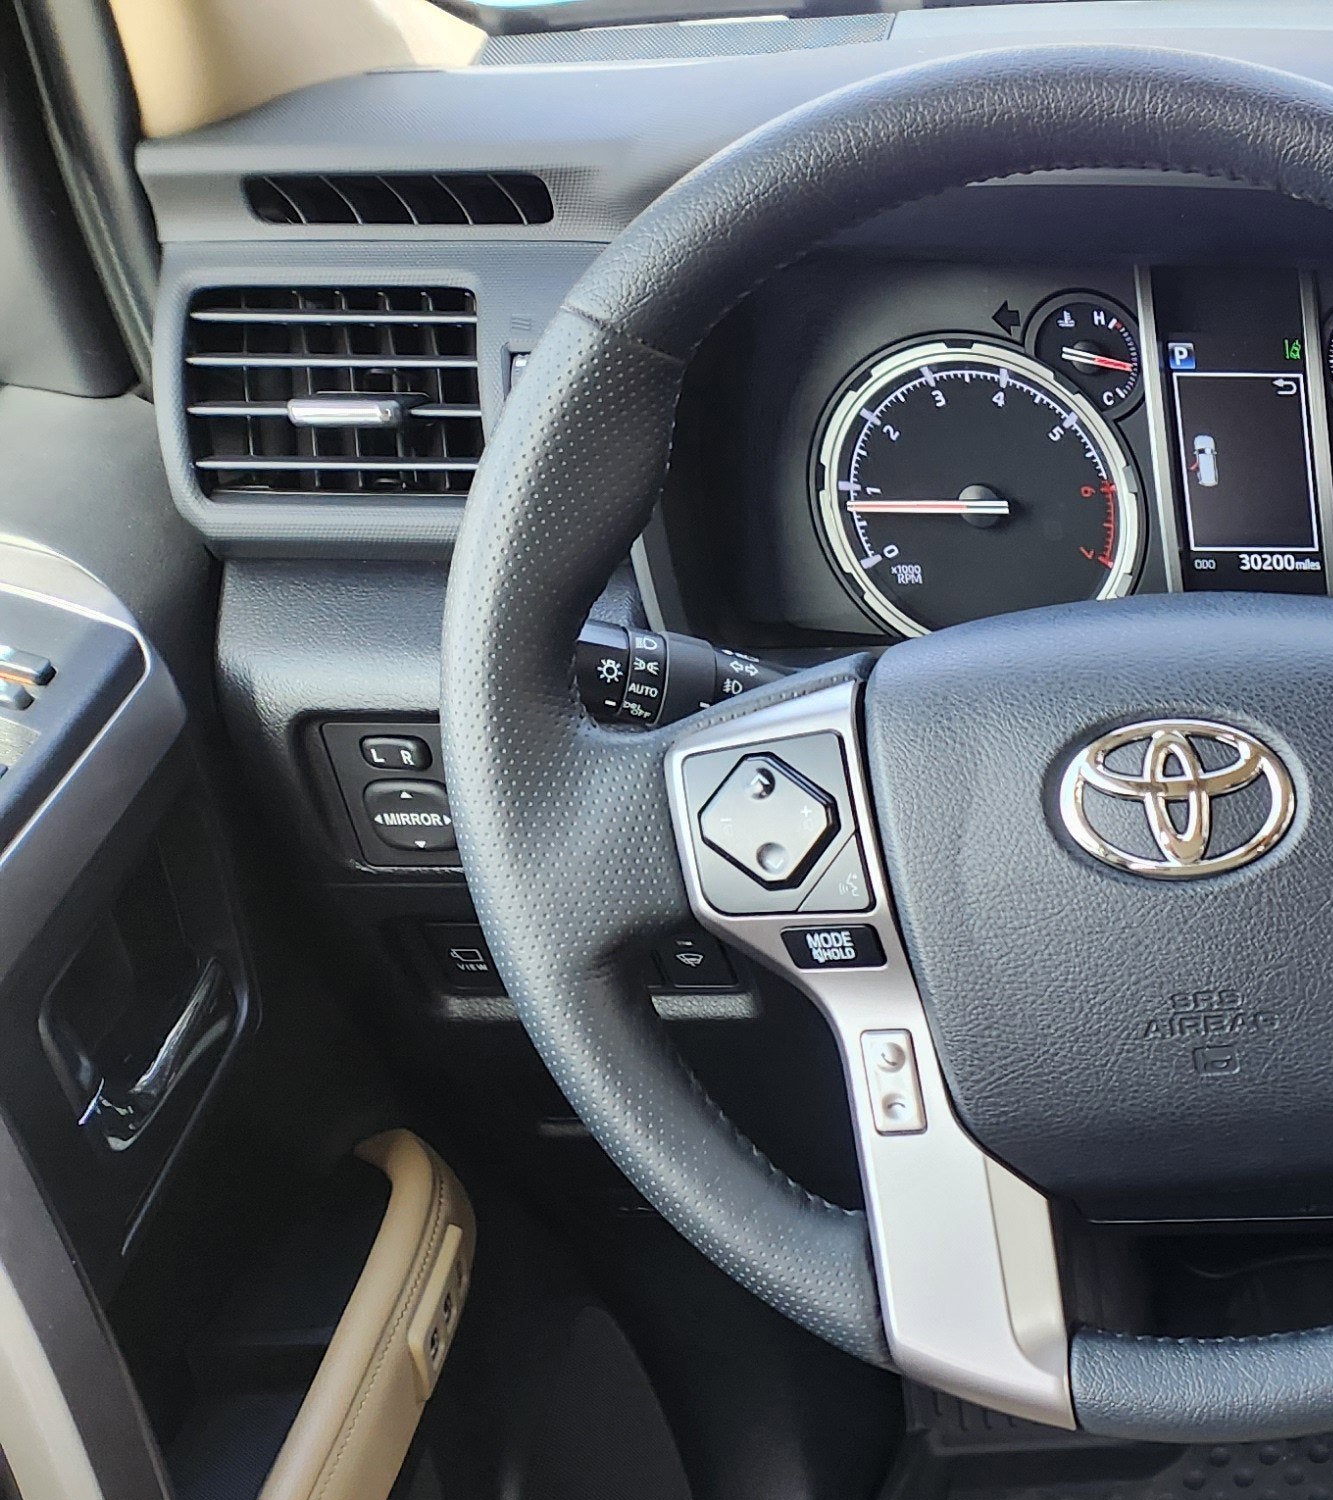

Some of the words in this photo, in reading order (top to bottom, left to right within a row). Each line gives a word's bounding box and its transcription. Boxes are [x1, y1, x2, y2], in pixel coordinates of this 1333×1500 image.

[1093, 311, 1105, 326] H
[1174, 347, 1188, 365] P
[931, 390, 946, 408] 3
[992, 391, 1005, 408] 4
[1102, 390, 1114, 405] C
[883, 425, 900, 442] 2
[1048, 426, 1064, 442] 5
[866, 486, 882, 496] 1
[1080, 486, 1096, 498] 6
[883, 544, 899, 558] 0
[1080, 546, 1094, 560] 7
[891, 565, 922, 575] x1000
[897, 573, 923, 584] RPM
[628, 682, 659, 698] AUTO
[371, 749, 385, 763] L
[400, 750, 414, 766] R
[384, 813, 443, 826] MIRROR
[806, 931, 855, 949] MODE
[824, 947, 856, 961] HOLD
[457, 963, 488, 971] VIEW
